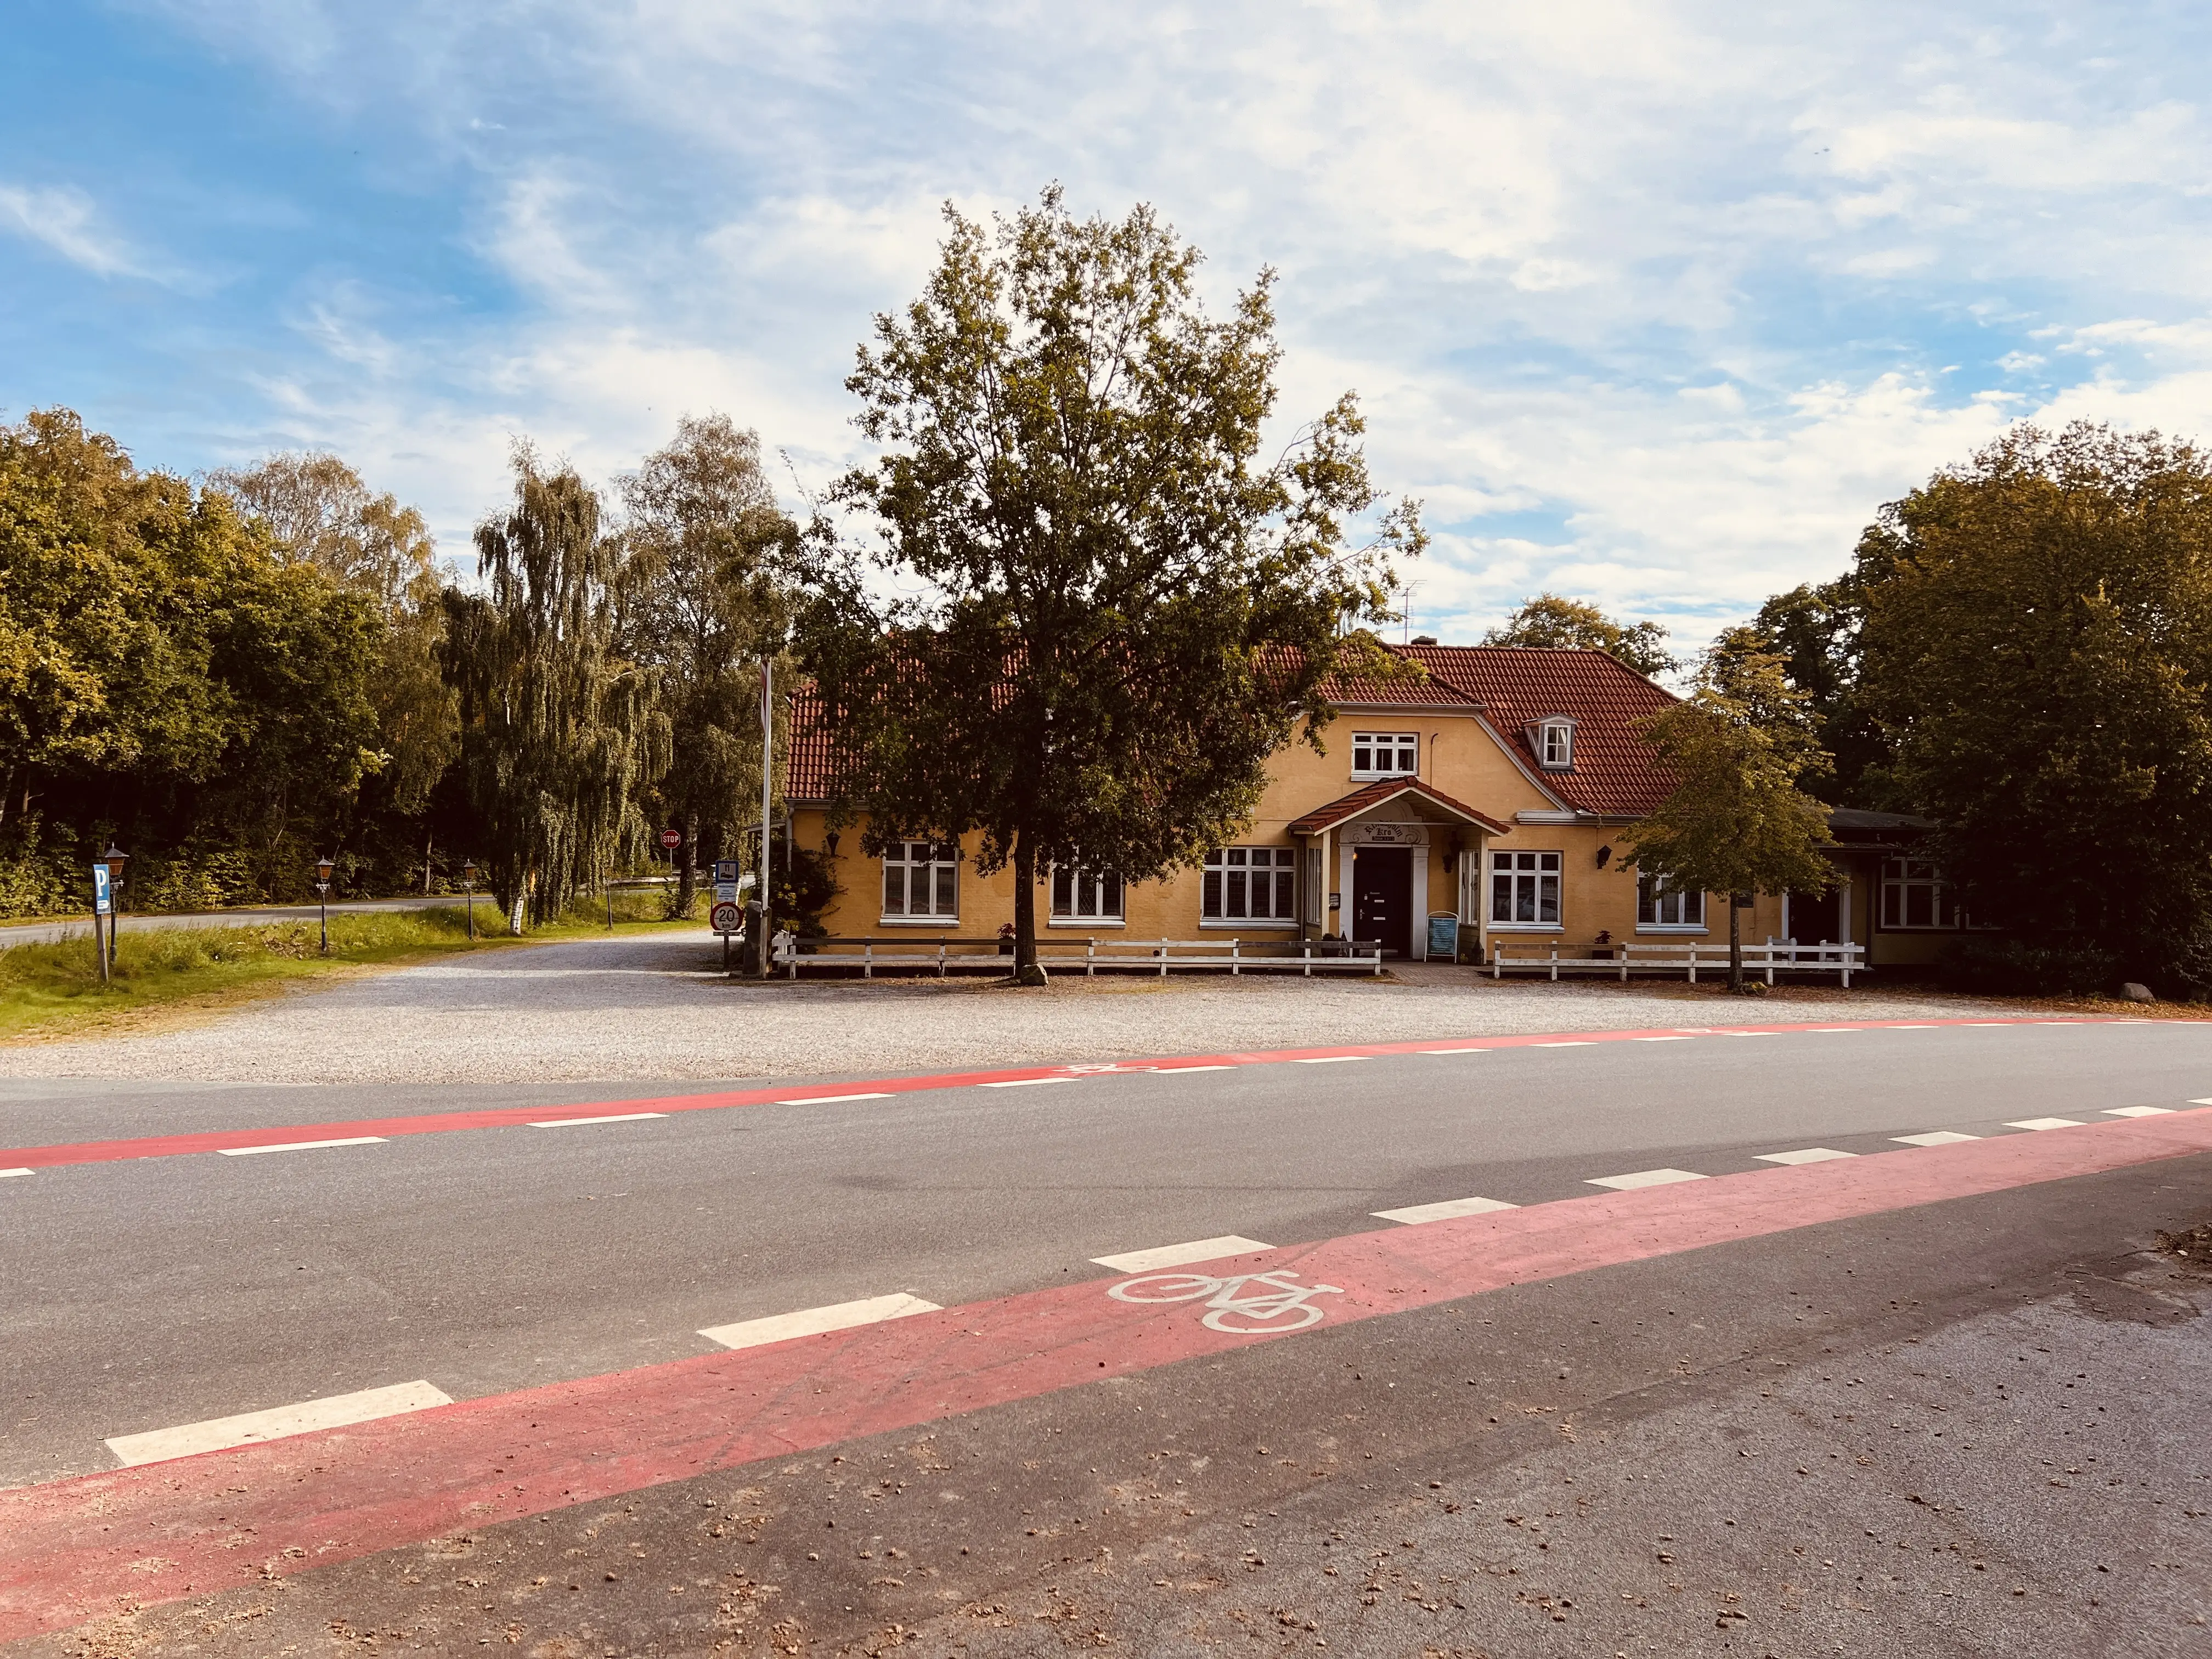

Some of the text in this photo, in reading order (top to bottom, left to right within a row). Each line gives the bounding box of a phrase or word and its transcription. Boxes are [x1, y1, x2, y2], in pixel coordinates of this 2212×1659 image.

[1376, 828, 1392, 836] Kro
[95, 870, 106, 897] P
[719, 909, 735, 922] 20
